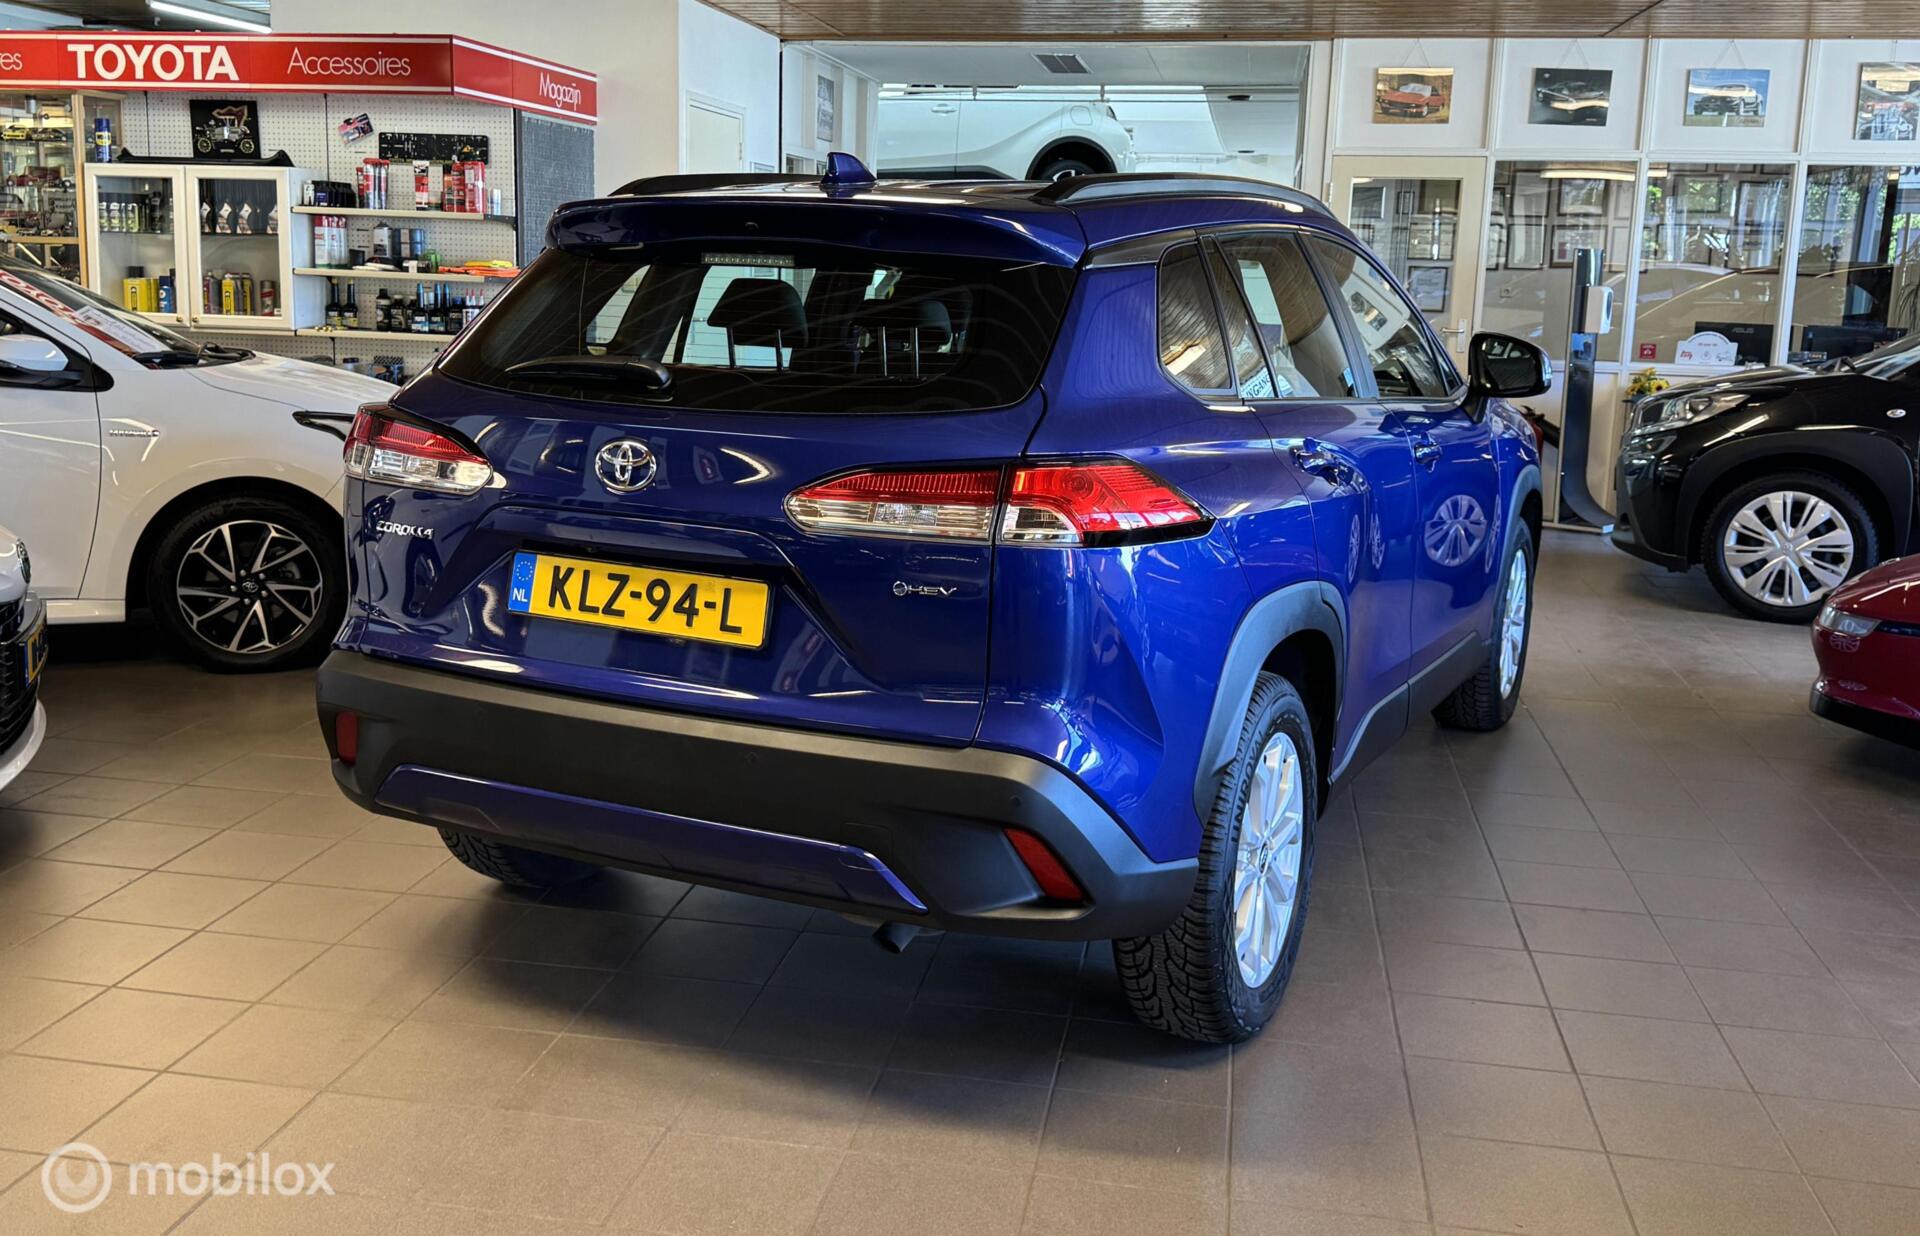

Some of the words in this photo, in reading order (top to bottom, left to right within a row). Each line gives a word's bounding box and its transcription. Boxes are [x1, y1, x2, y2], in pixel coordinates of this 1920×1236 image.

[0, 52, 23, 71] es
[67, 43, 240, 81] TOYOTA
[287, 47, 411, 77] Accessoires
[538, 72, 582, 110] Magazijn
[512, 587, 528, 603] NL
[548, 565, 743, 634] KLZ-94-L
